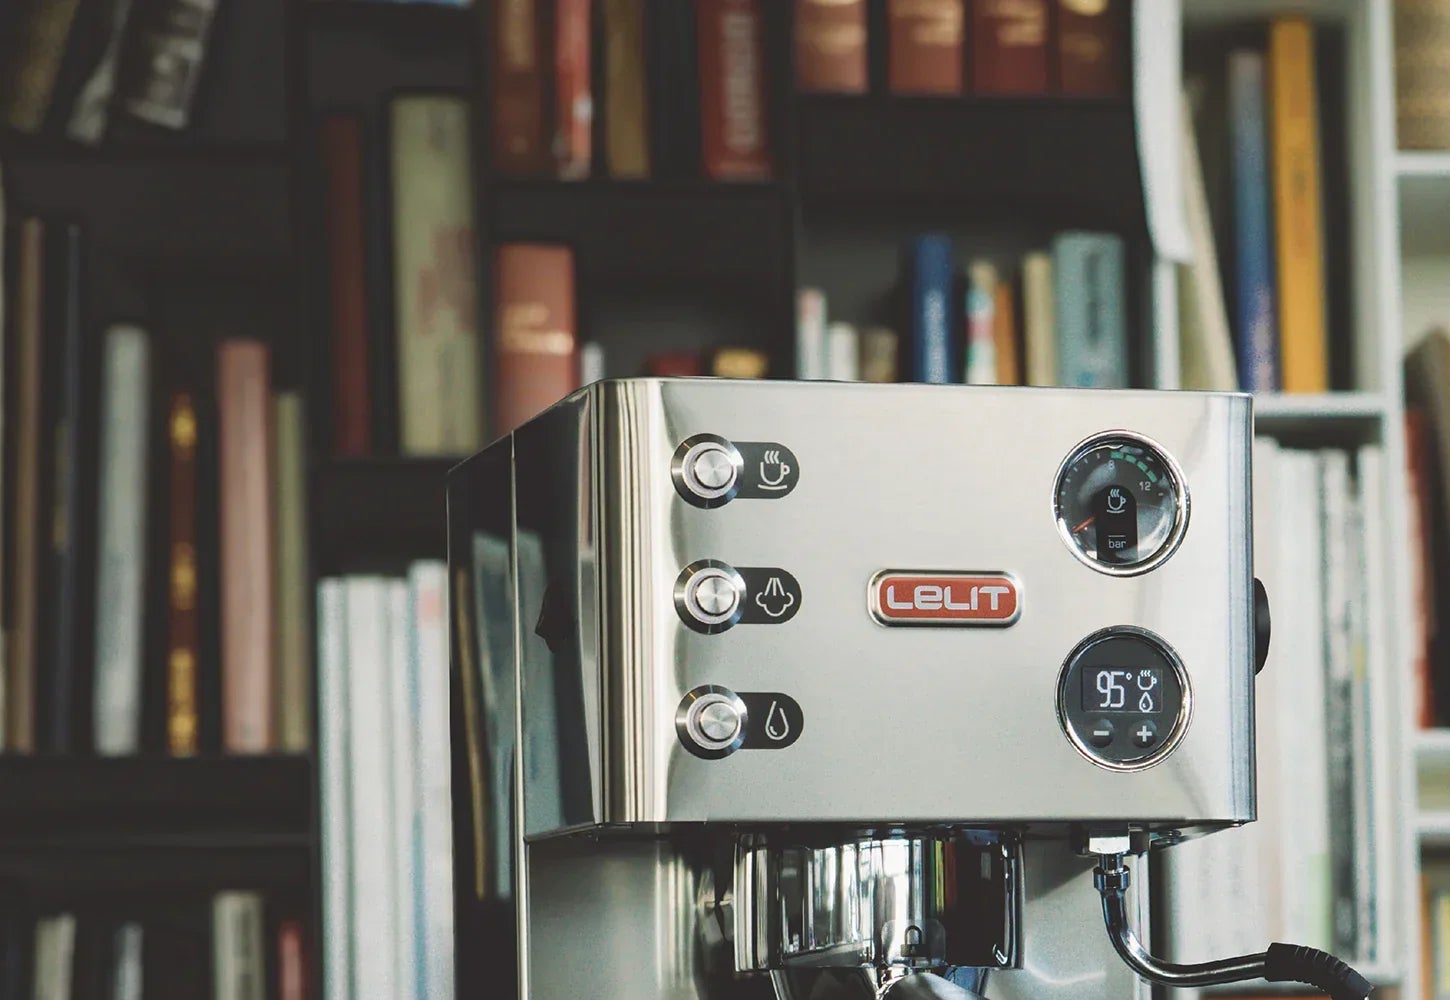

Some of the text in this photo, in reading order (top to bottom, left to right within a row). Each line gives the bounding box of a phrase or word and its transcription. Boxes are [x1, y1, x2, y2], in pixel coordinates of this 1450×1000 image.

[1107, 459, 1116, 470] 8
[1138, 481, 1152, 491] 12
[1107, 540, 1127, 549] bar
